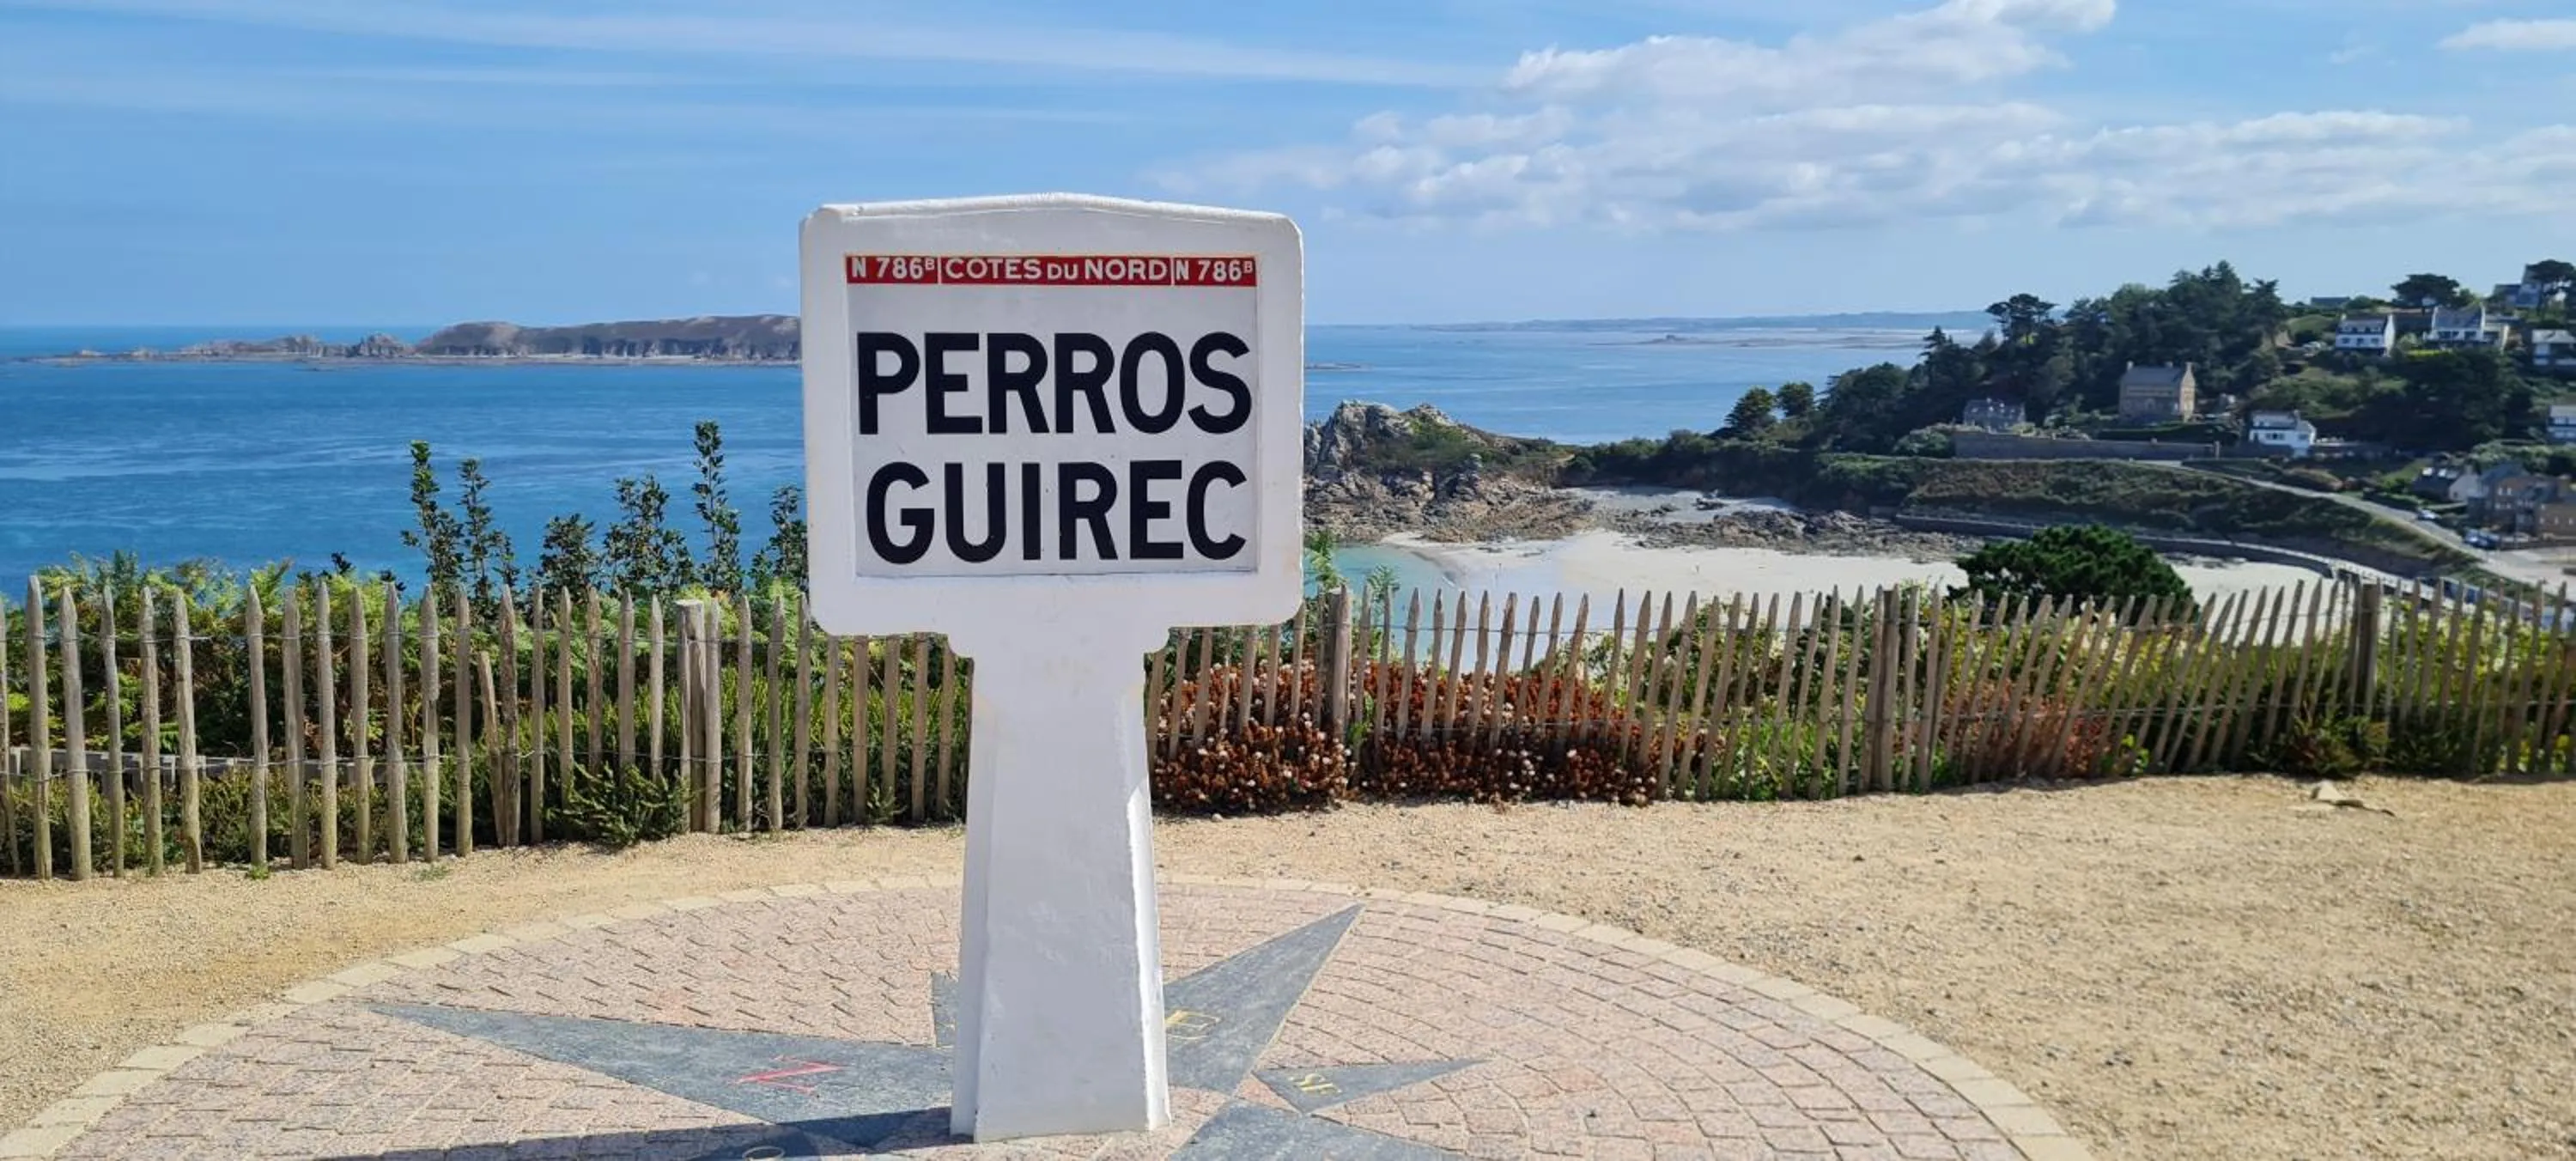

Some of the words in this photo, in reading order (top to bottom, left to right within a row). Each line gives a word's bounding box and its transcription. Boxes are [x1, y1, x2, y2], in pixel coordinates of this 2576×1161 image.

[851, 258, 866, 278] N
[945, 258, 1042, 280] COTES
[1047, 263, 1078, 280] DU
[1084, 258, 1168, 281] NORD
[1175, 259, 1190, 280] N
[857, 331, 1252, 435] PERROS
[866, 459, 1248, 565] GUIREC
